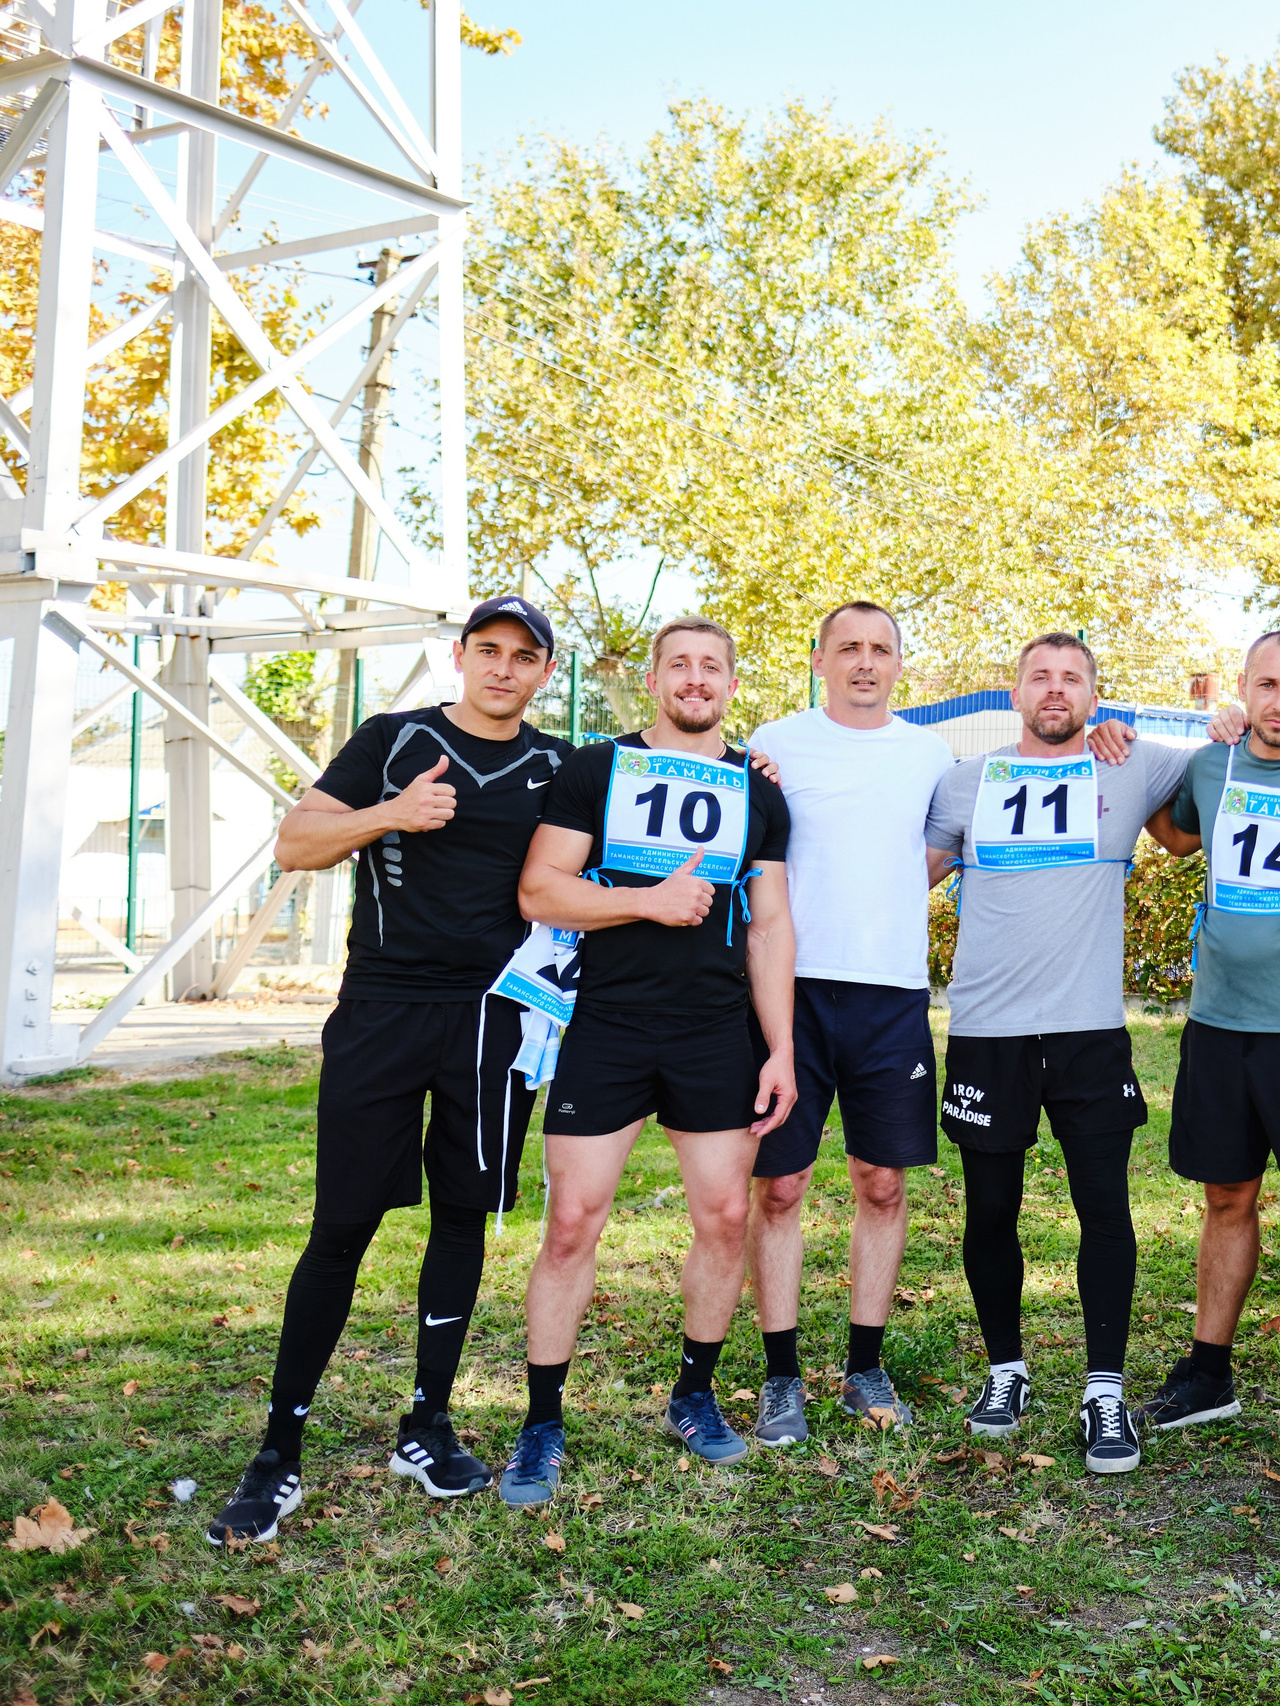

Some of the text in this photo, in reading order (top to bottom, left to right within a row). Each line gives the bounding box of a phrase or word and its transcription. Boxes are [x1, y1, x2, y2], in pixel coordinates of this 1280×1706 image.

[652, 757, 701, 770] СПОРТИВНЫЙ
[652, 763, 742, 788] ТАМАНЬ
[634, 783, 722, 844] 10
[1003, 784, 1068, 835] 11
[610, 852, 732, 871] ТАМАНСКОГО СЕЛЬСКО ОСЕЛЕНИЯ
[642, 849, 691, 859] АДМИНИСТРА
[505, 981, 545, 1007] ТАМАНСКОГО
[953, 1083, 985, 1103] IRON
[942, 1100, 992, 1127] PARADISE
